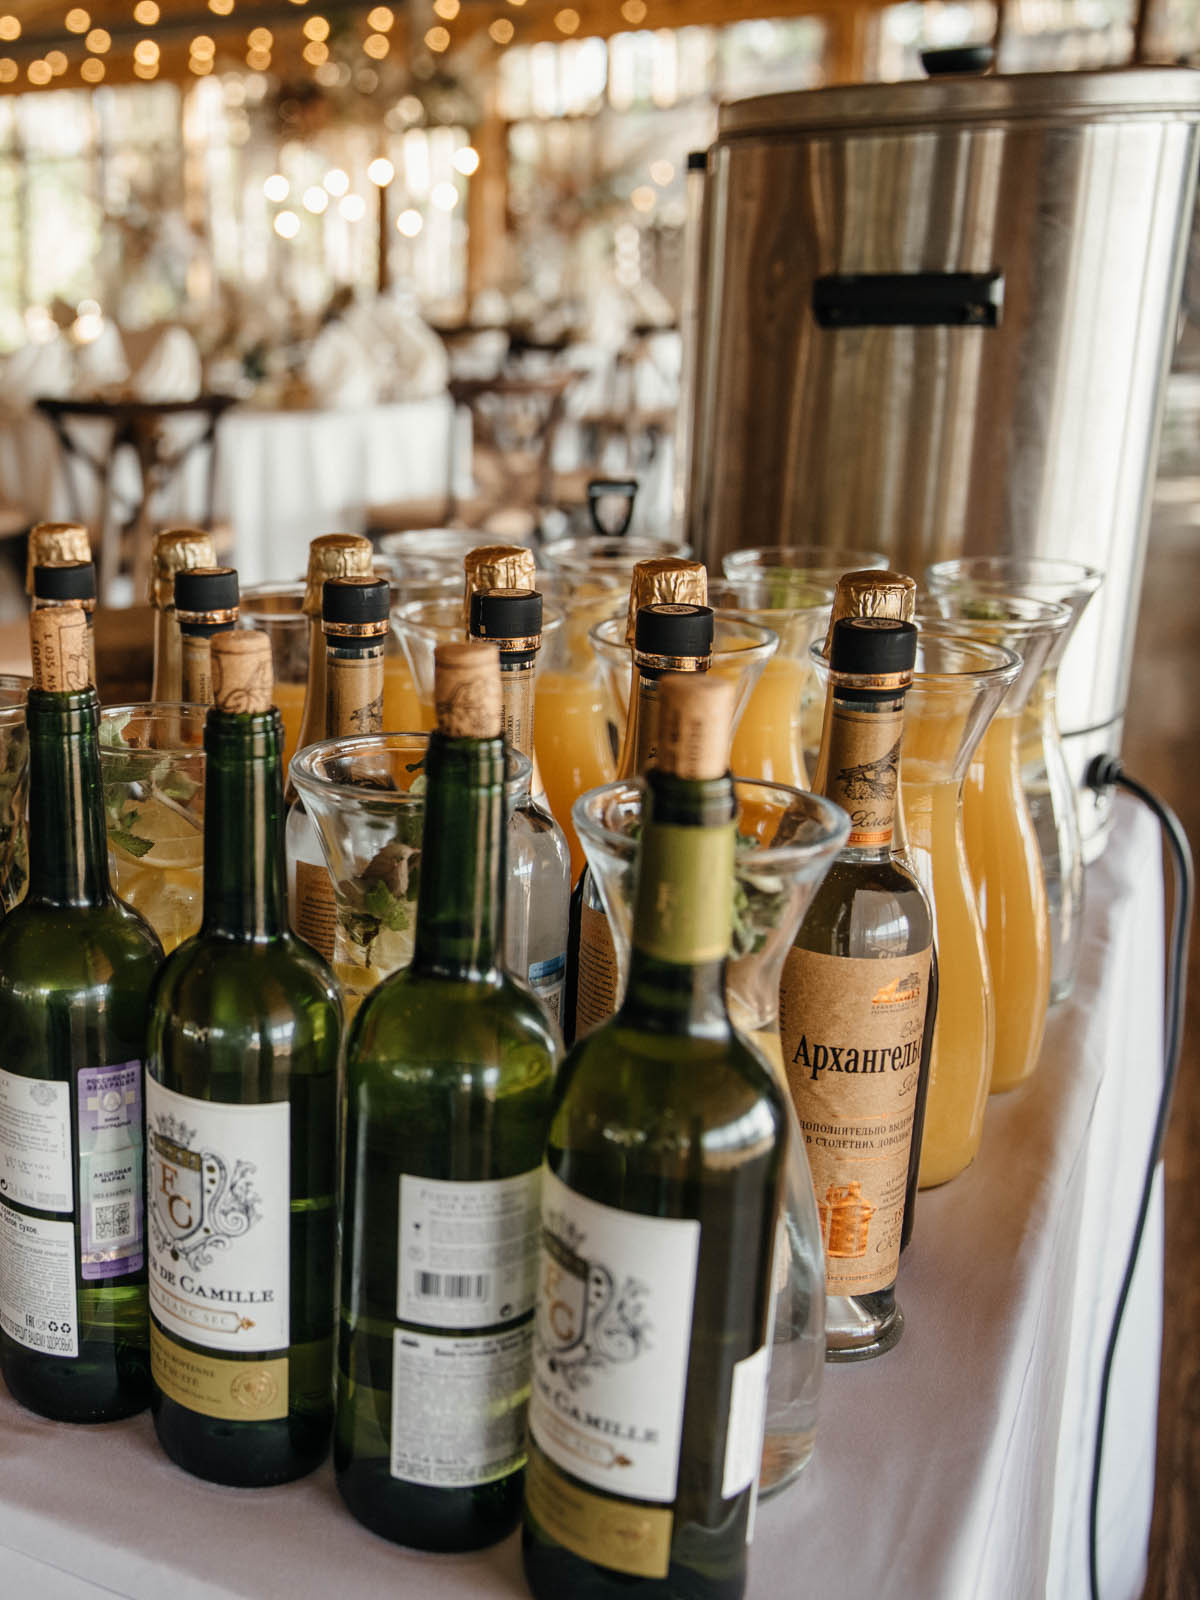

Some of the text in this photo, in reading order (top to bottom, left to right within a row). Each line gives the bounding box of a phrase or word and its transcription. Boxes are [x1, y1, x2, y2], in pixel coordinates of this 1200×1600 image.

[806, 1135, 812, 1144] В
[816, 1136, 875, 1149] СТОЛЕТНИХ
[159, 1265, 176, 1286] DE
[179, 1275, 275, 1304] CAMILLE
[553, 1390, 660, 1444] CAMILLE
